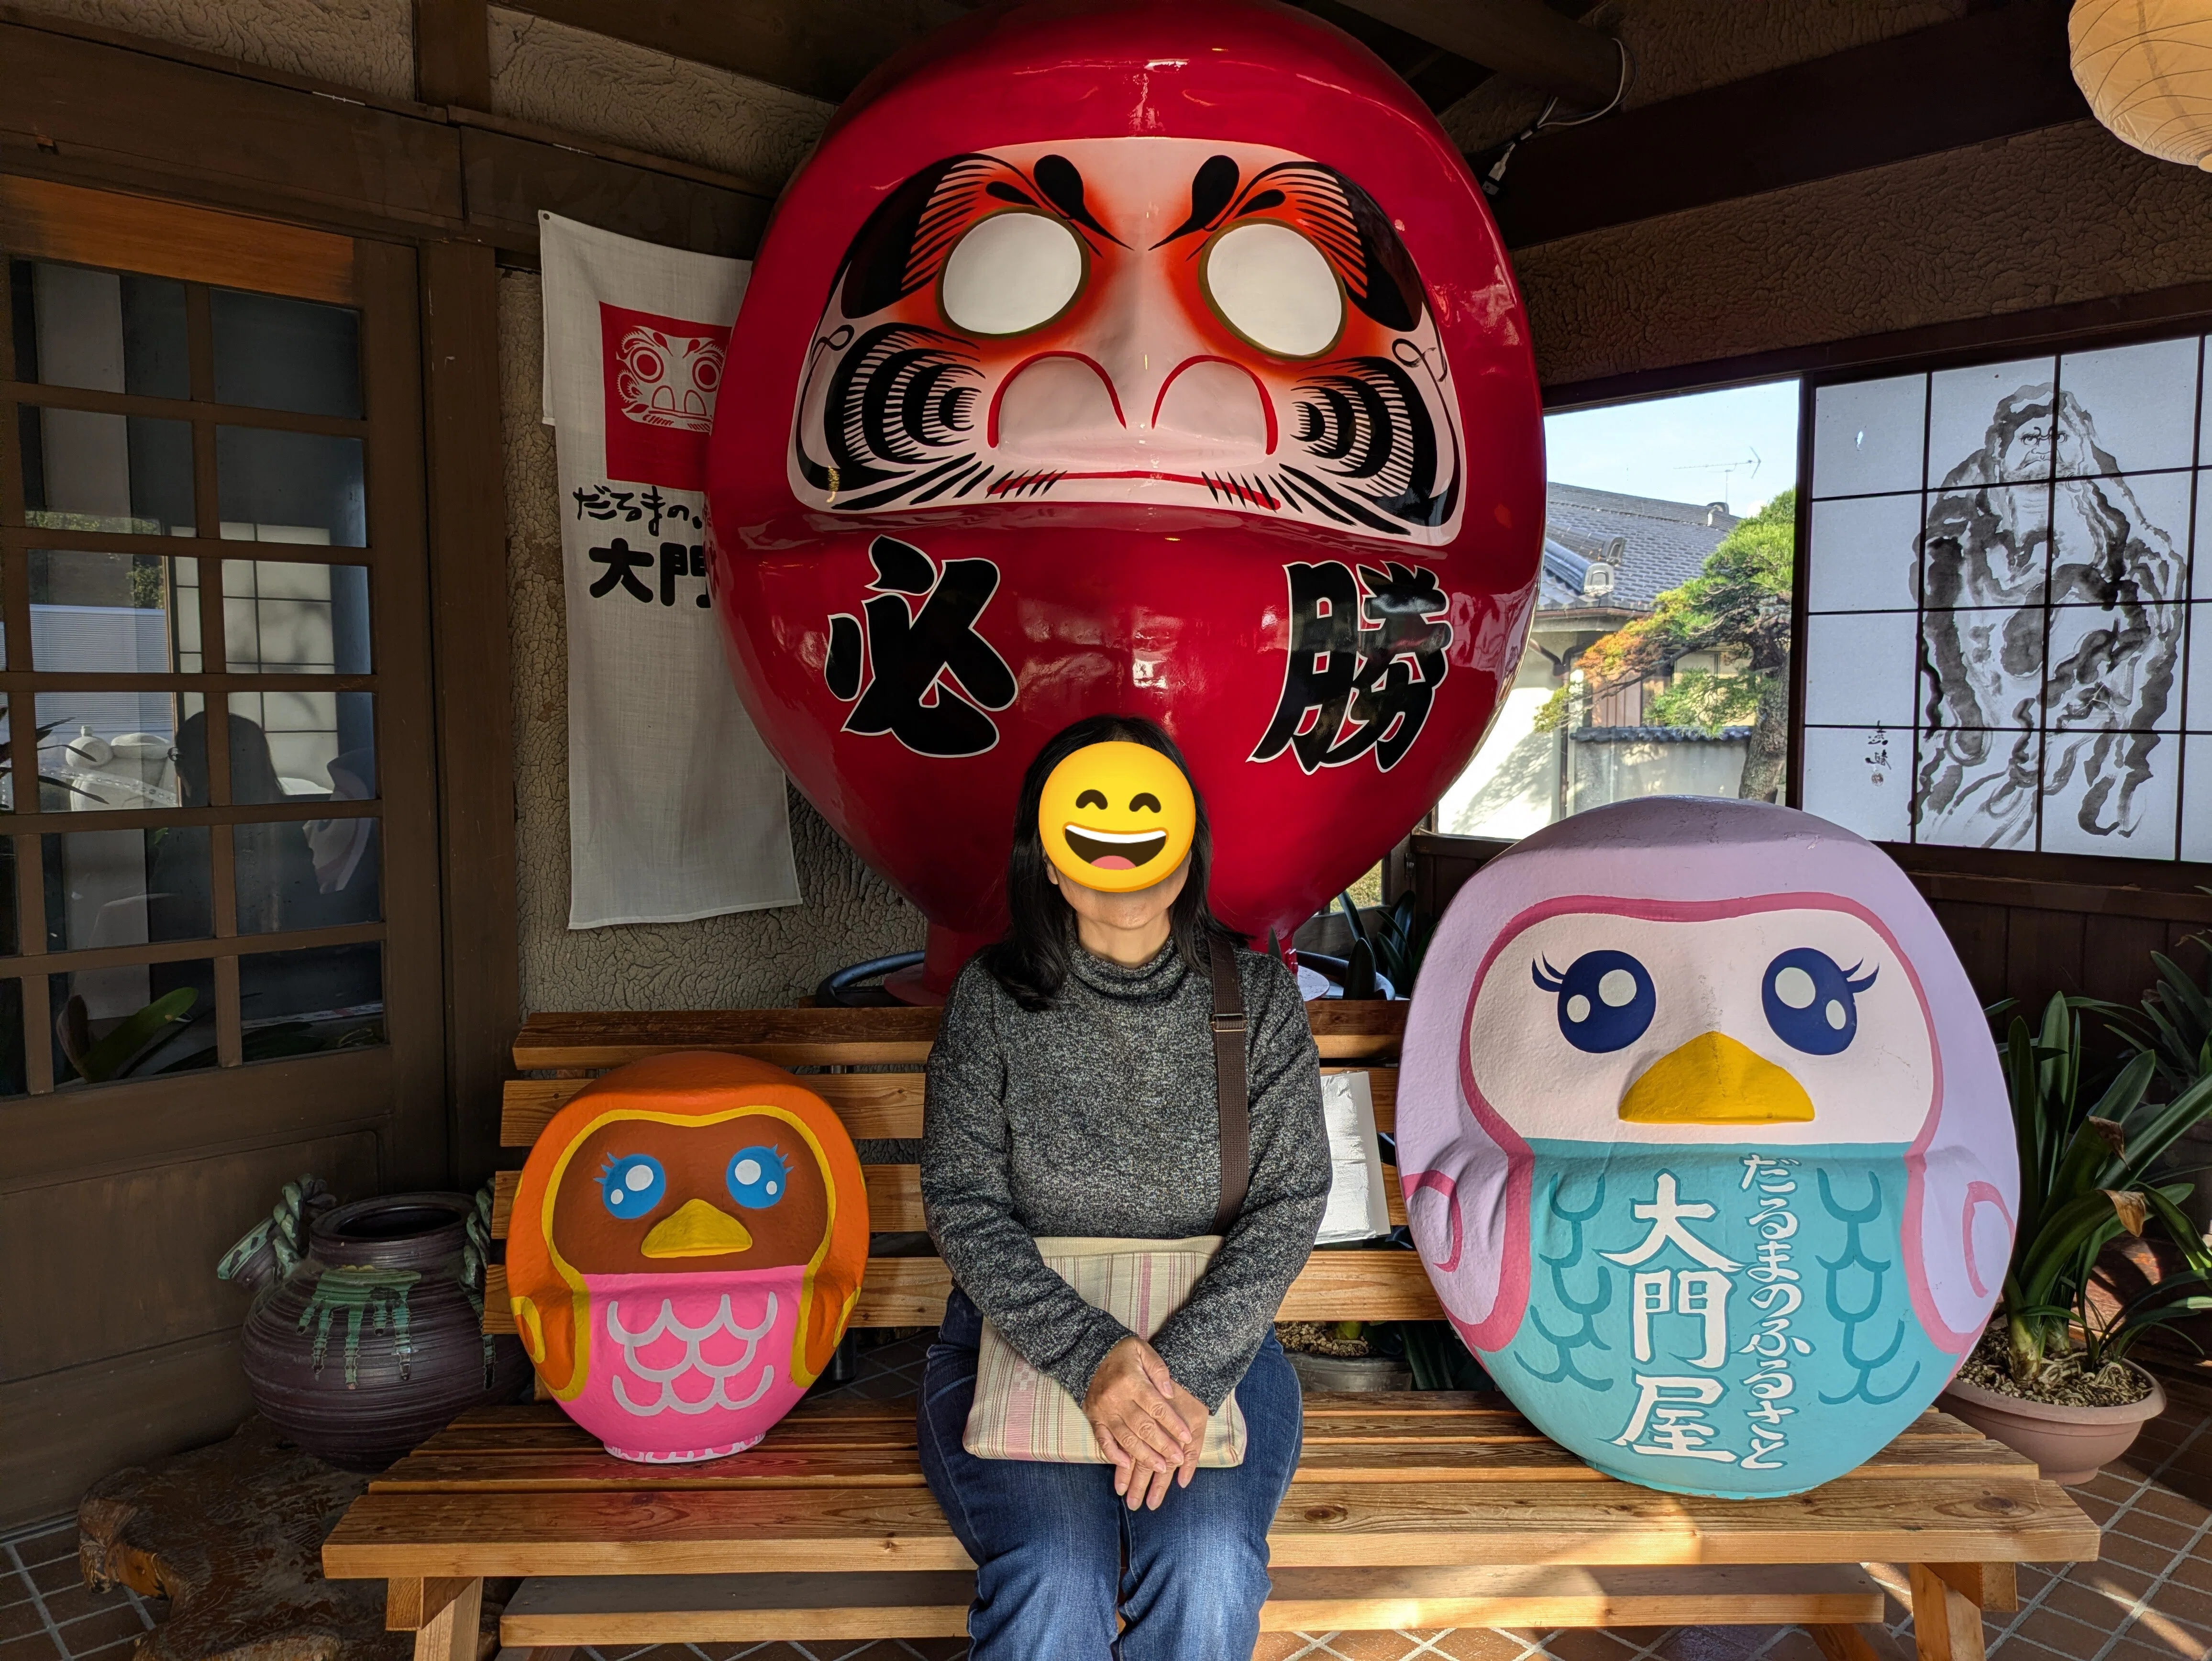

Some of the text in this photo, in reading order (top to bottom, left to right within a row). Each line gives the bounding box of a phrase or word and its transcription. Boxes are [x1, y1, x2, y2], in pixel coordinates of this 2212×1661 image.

[573, 485, 703, 537] だるまの
[825, 535, 1450, 775] 必 勝
[1598, 1171, 1744, 1463] 大門屋
[1739, 1154, 1814, 1469] だるまのふるさと
